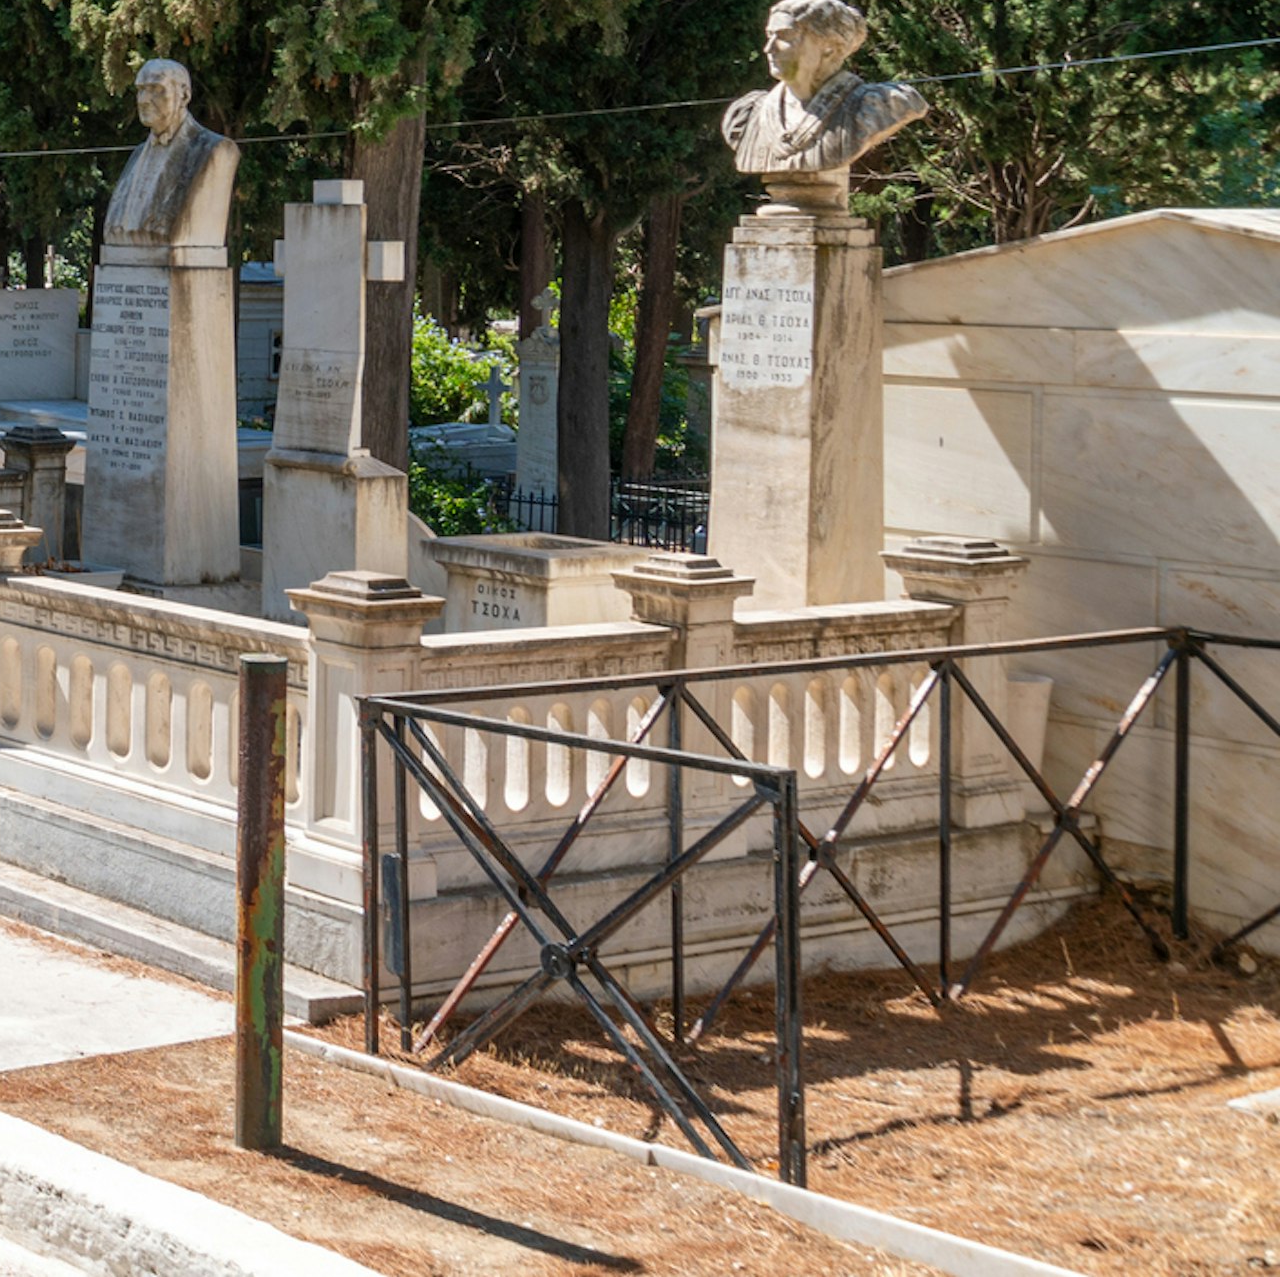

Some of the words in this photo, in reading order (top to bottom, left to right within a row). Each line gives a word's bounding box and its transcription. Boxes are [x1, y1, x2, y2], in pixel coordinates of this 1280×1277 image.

[777, 288, 812, 304] ΤΣΟΧΑ
[772, 315, 809, 328] ΤΣΟΧΑ
[767, 354, 811, 369] ΤΣΟΧΑΣ
[477, 583, 516, 600] ΟΙΚΟΣ
[471, 600, 521, 622] ΤΣΟΧΑ
